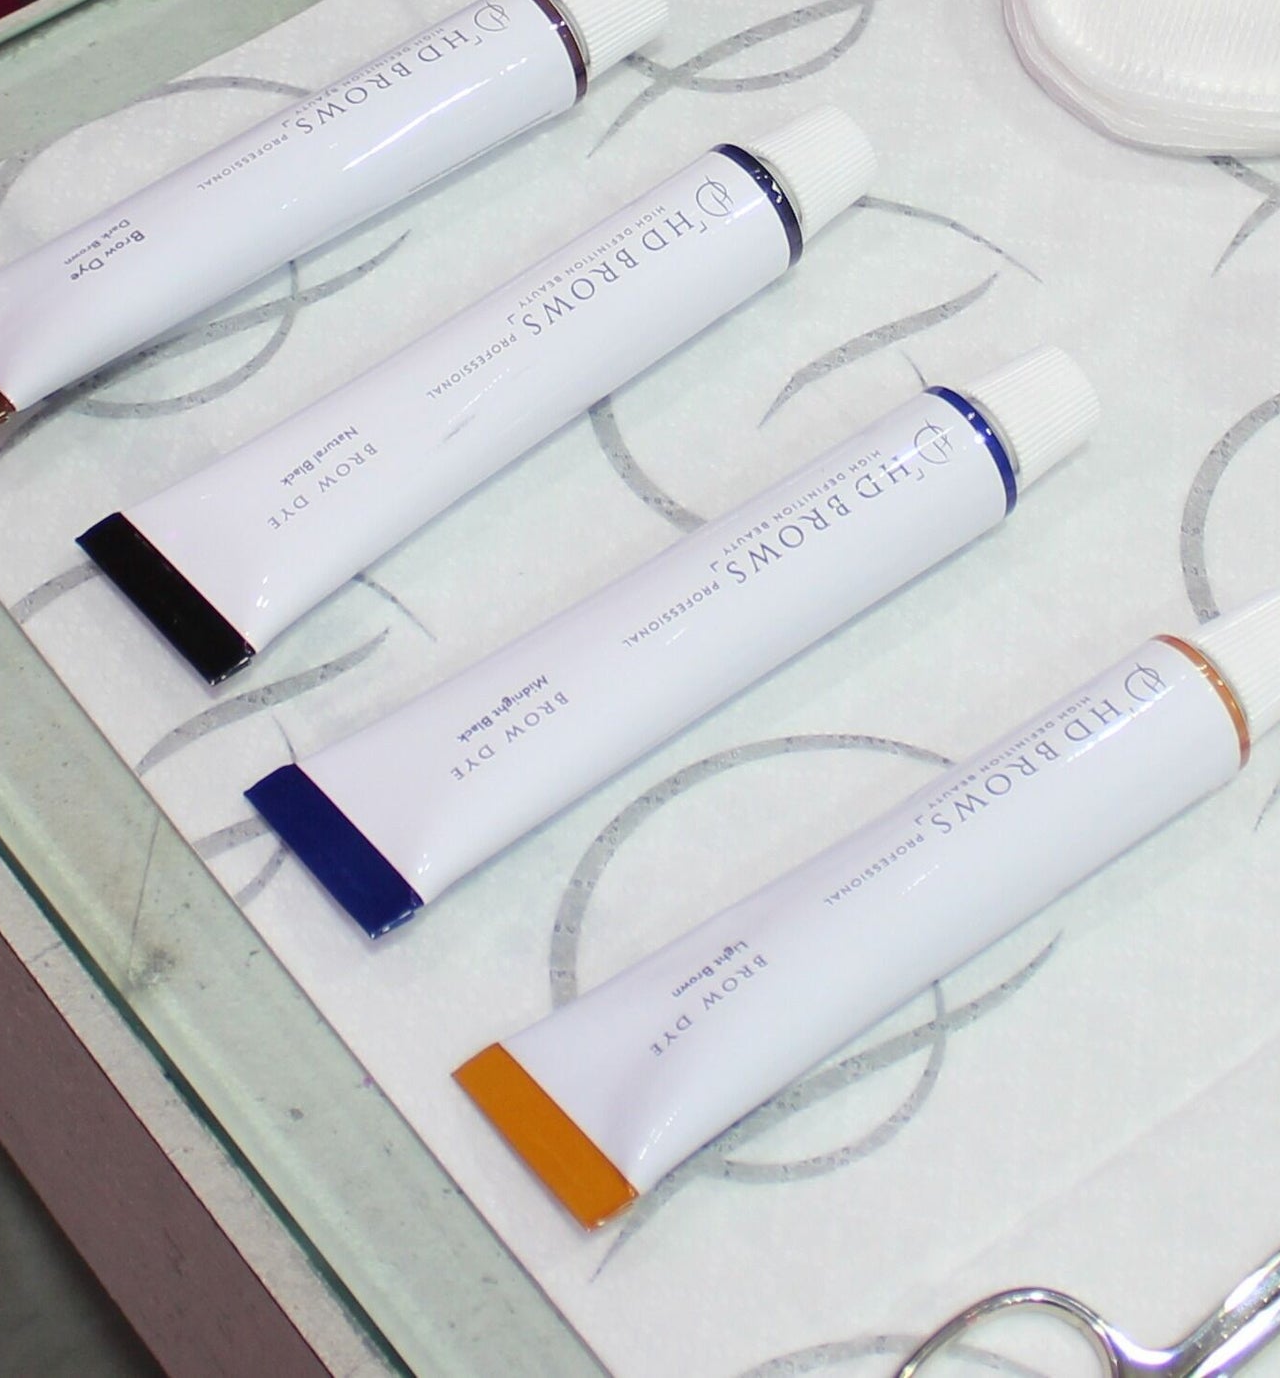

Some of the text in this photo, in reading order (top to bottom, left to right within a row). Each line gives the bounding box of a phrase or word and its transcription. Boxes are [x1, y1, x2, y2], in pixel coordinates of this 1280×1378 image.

[295, 29, 470, 135] HD BROWS
[196, 133, 288, 191] PROFESSIONAL
[70, 230, 145, 280] Brow Dye
[519, 205, 666, 309] HIGH DEFINITION BEAUTY
[521, 210, 694, 337] HD BROWS
[426, 333, 517, 400] PROFESSIONAL
[267, 443, 378, 530] BROW DYE
[280, 425, 359, 487] Natural Black
[722, 448, 881, 557] HIGH DEFINITION BEAUTY
[725, 455, 912, 585] HD BROWS
[621, 581, 720, 649] PROFESSIONAL
[450, 690, 569, 781] BROW DYE
[457, 674, 549, 743] Midnight Black
[930, 698, 1123, 835] HD BROWS
[822, 832, 925, 907] PROFESSIONAL
[649, 954, 768, 1057] BROW DYE
[671, 940, 750, 998] Light Brown
